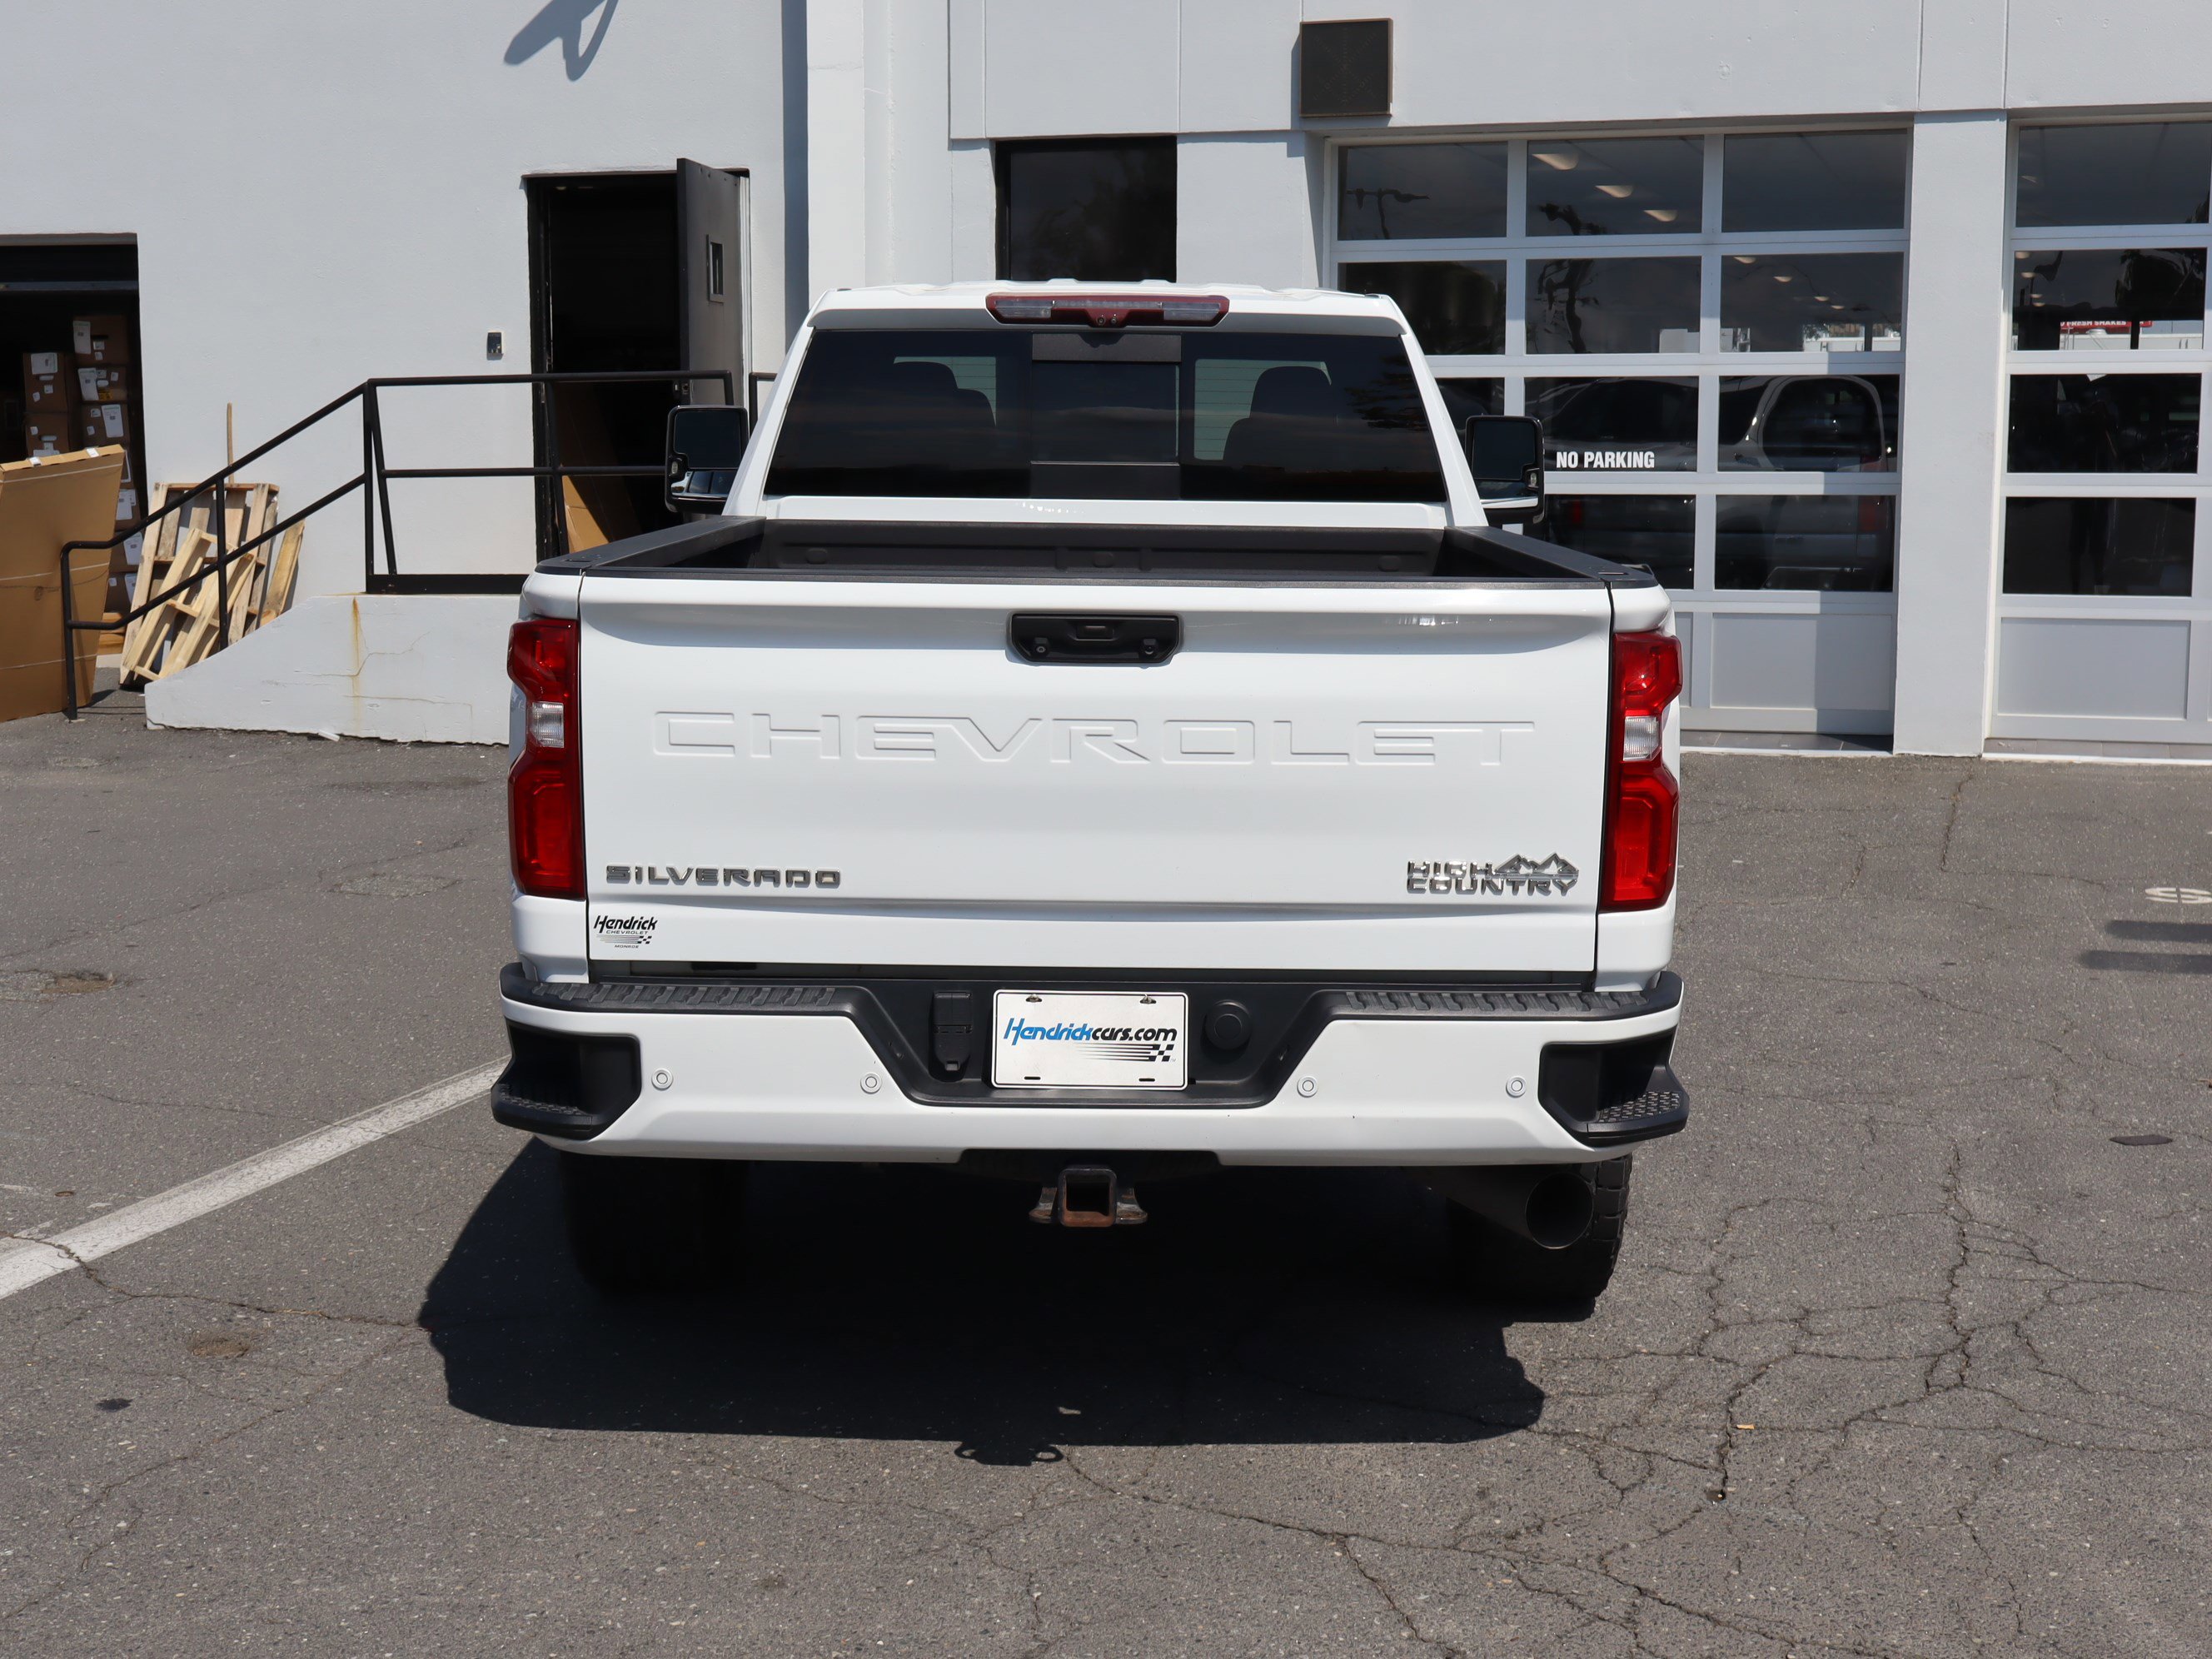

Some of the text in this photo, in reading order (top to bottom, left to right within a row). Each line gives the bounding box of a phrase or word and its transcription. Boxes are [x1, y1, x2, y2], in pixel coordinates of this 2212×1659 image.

[1556, 451, 1655, 469] NO PARKING
[653, 710, 1535, 766] CHEVROLET
[606, 864, 840, 888] SILVERADO
[1407, 860, 1497, 878] HIGH
[1407, 877, 1577, 896] COUNTRY
[593, 914, 658, 934] Hendrick
[1003, 1018, 1178, 1046] Hendrickcars.com
